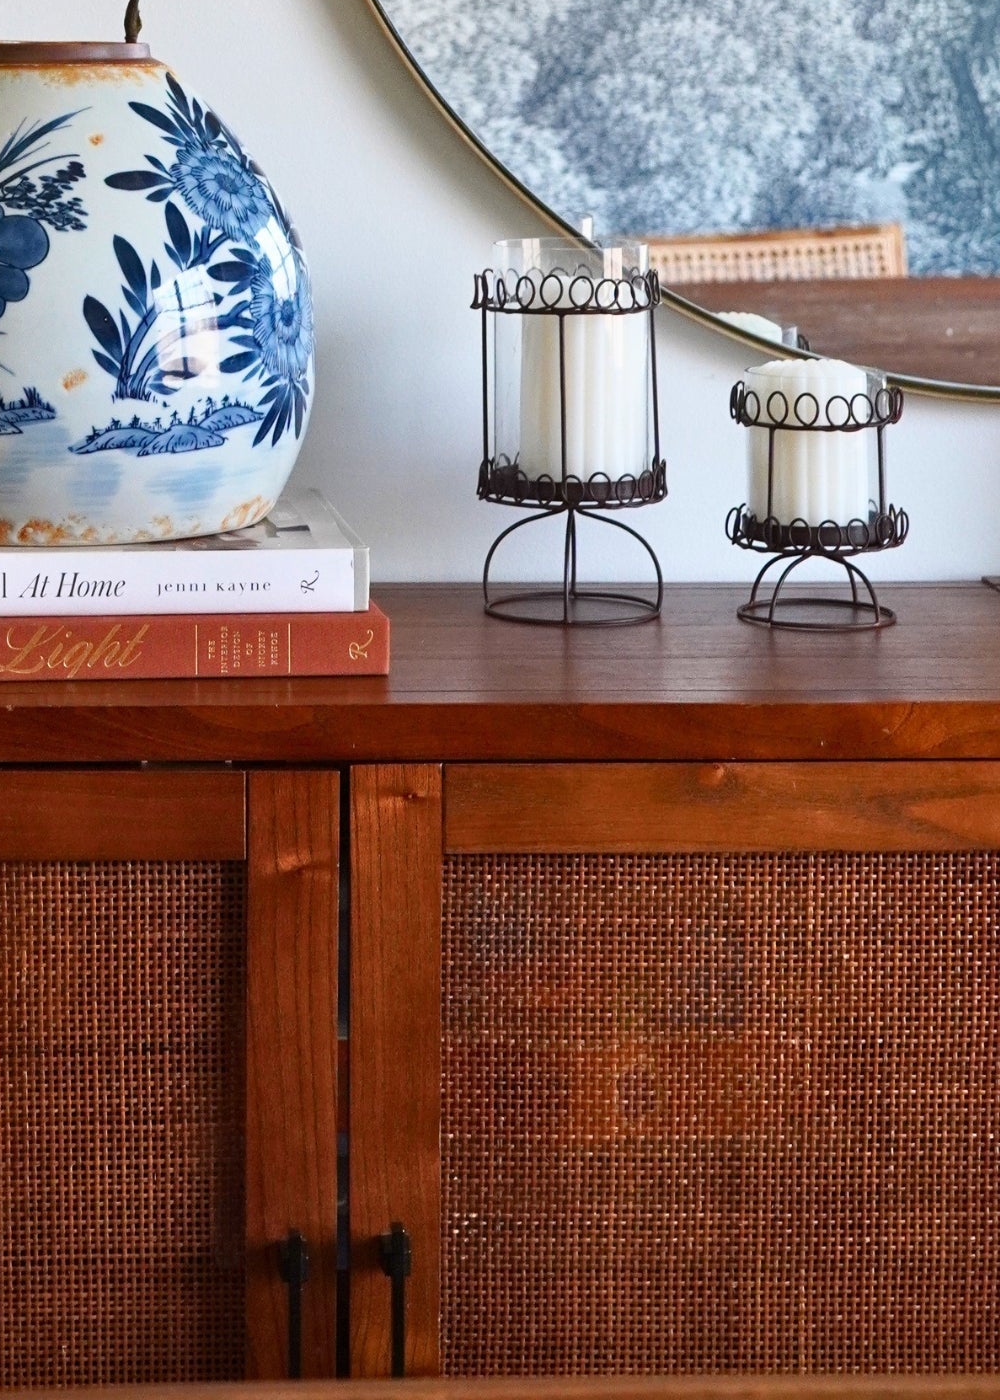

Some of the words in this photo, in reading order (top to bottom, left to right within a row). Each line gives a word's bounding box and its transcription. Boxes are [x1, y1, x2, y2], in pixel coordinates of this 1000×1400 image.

[18, 572, 51, 599] At
[55, 571, 126, 599] Home
[208, 639, 216, 660] THE
[220, 625, 229, 674] INTERIOR
[233, 630, 241, 669] DESIGN
[245, 642, 253, 656] OF
